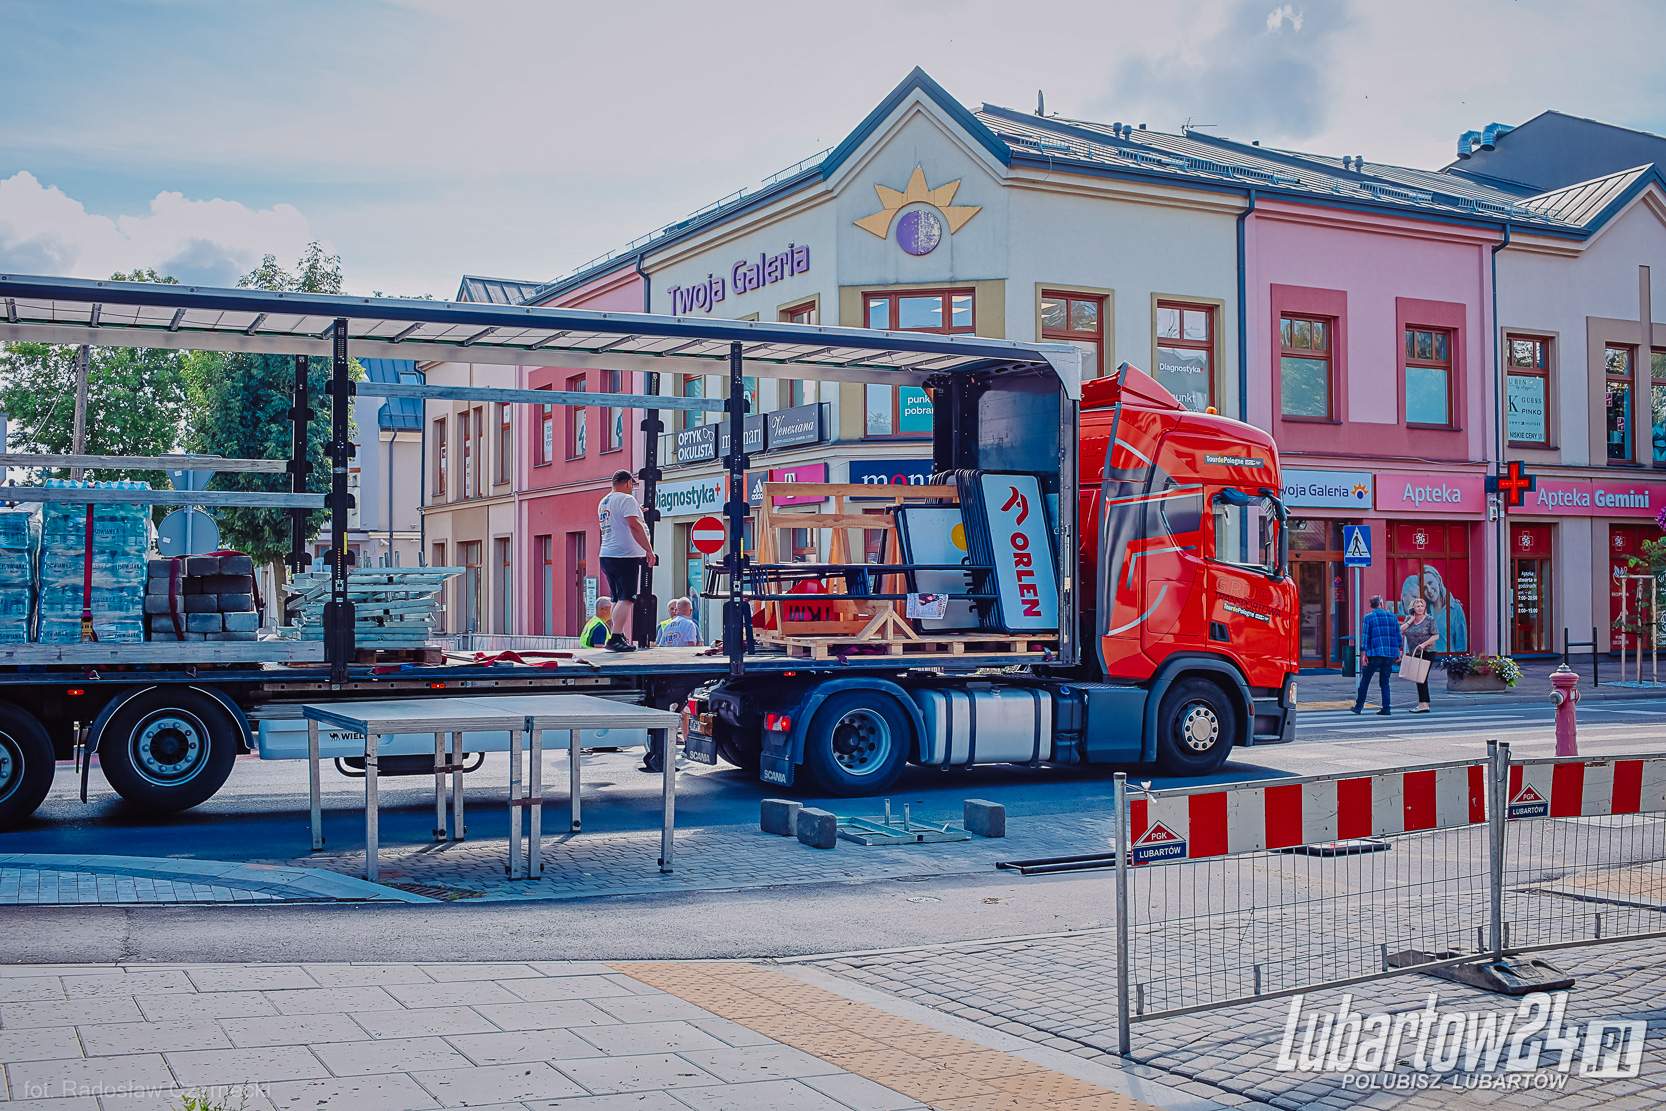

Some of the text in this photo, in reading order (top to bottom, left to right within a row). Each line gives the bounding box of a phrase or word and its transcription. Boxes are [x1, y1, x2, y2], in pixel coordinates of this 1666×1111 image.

[667, 241, 810, 316] Twoja Galeria
[1159, 362, 1201, 374] Diagnostyka
[907, 394, 932, 406] punk
[1174, 392, 1196, 404] unkt
[904, 406, 934, 417] pobra
[771, 414, 815, 437] Veneziana
[678, 429, 702, 446] OPTYK
[721, 427, 762, 449] mnari
[678, 444, 714, 461] OKULISTA
[1282, 484, 1349, 498] woja Galeria
[1402, 482, 1462, 507] Apteka
[1537, 488, 1649, 510] Apteka Gemini
[1010, 531, 1042, 617] ORLEN
[689, 750, 710, 763] SCANIA
[764, 769, 787, 784] SCANIA
[1512, 806, 1545, 816] LUBARTÓW
[1151, 831, 1167, 840] PGK
[1139, 846, 1182, 858] LUBARTÓW
